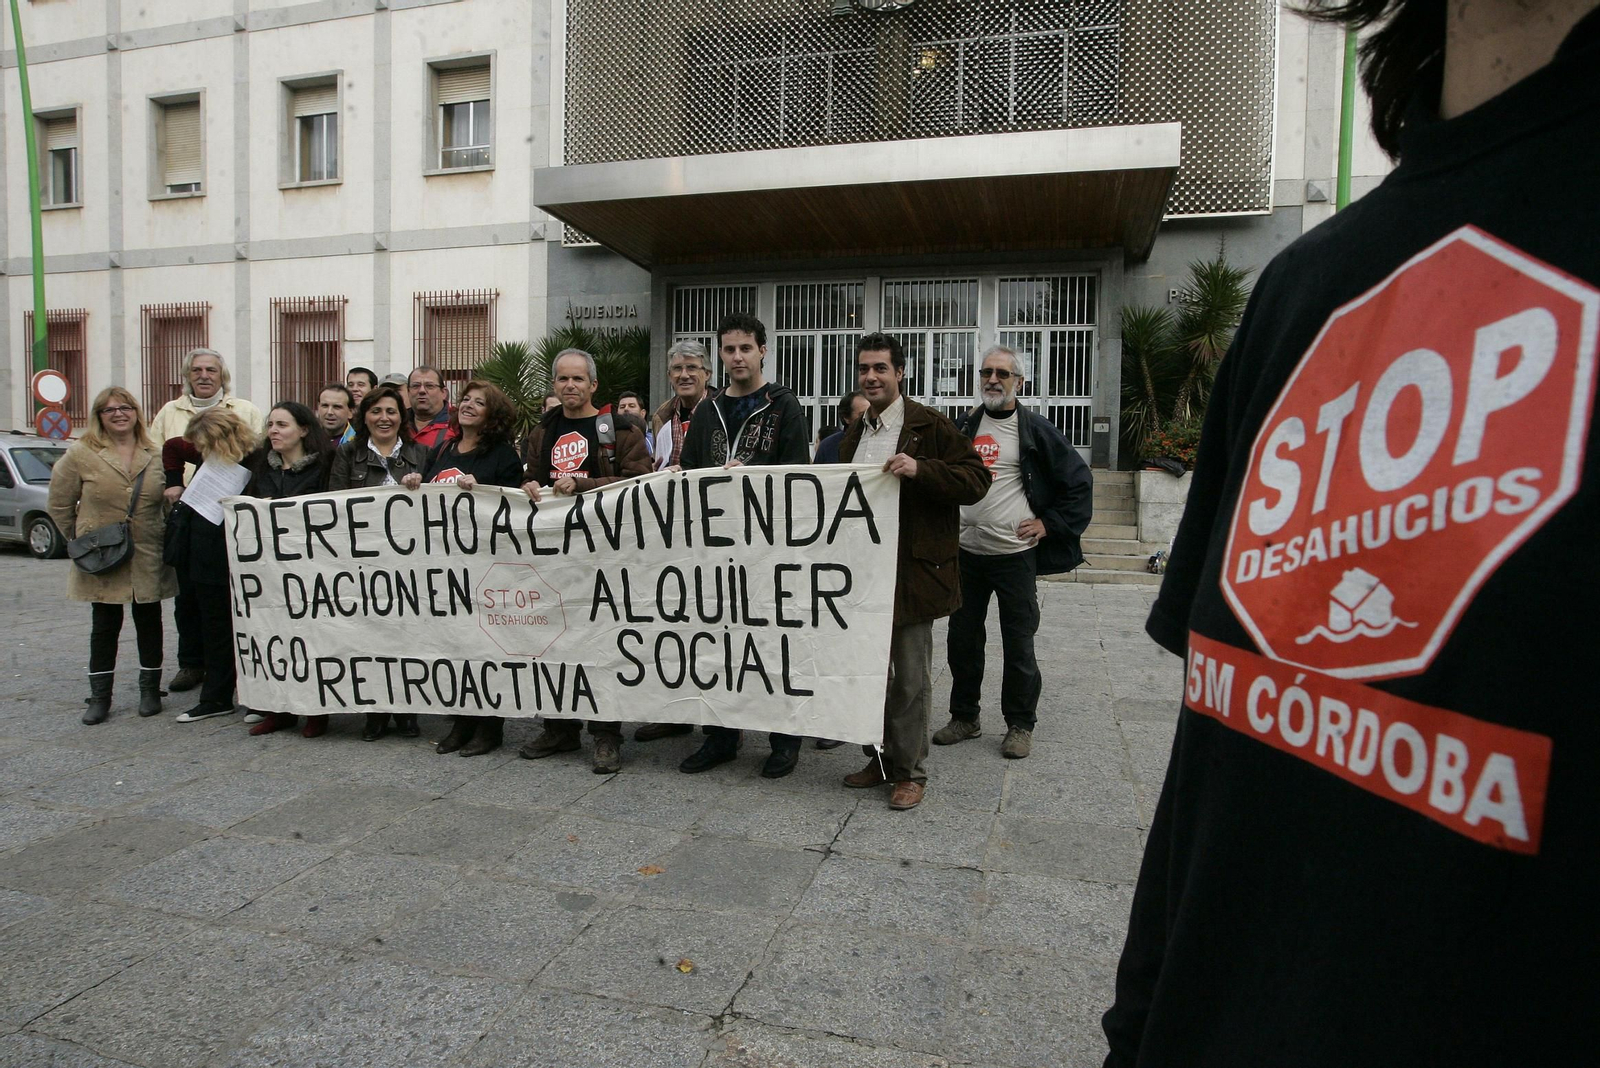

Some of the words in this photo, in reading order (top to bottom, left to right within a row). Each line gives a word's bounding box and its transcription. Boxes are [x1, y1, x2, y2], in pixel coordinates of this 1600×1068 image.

[565, 304, 638, 319] AUDIENCIA
[553, 440, 586, 460] STOP
[974, 443, 998, 456] TOP
[1248, 307, 1559, 536] STOP
[233, 492, 479, 562] DERECHO
[593, 471, 882, 551] VIVIENDA
[1235, 467, 1543, 584] DESAHUCIOS
[426, 567, 473, 617] EN
[483, 588, 541, 609] STOP
[487, 613, 549, 626] DESAHUCIOS
[589, 557, 853, 630] ALQUILER
[315, 656, 599, 714] RETROACTIVA
[616, 624, 814, 697] SOCIAL
[1246, 673, 1530, 842] CÓRDOBA
